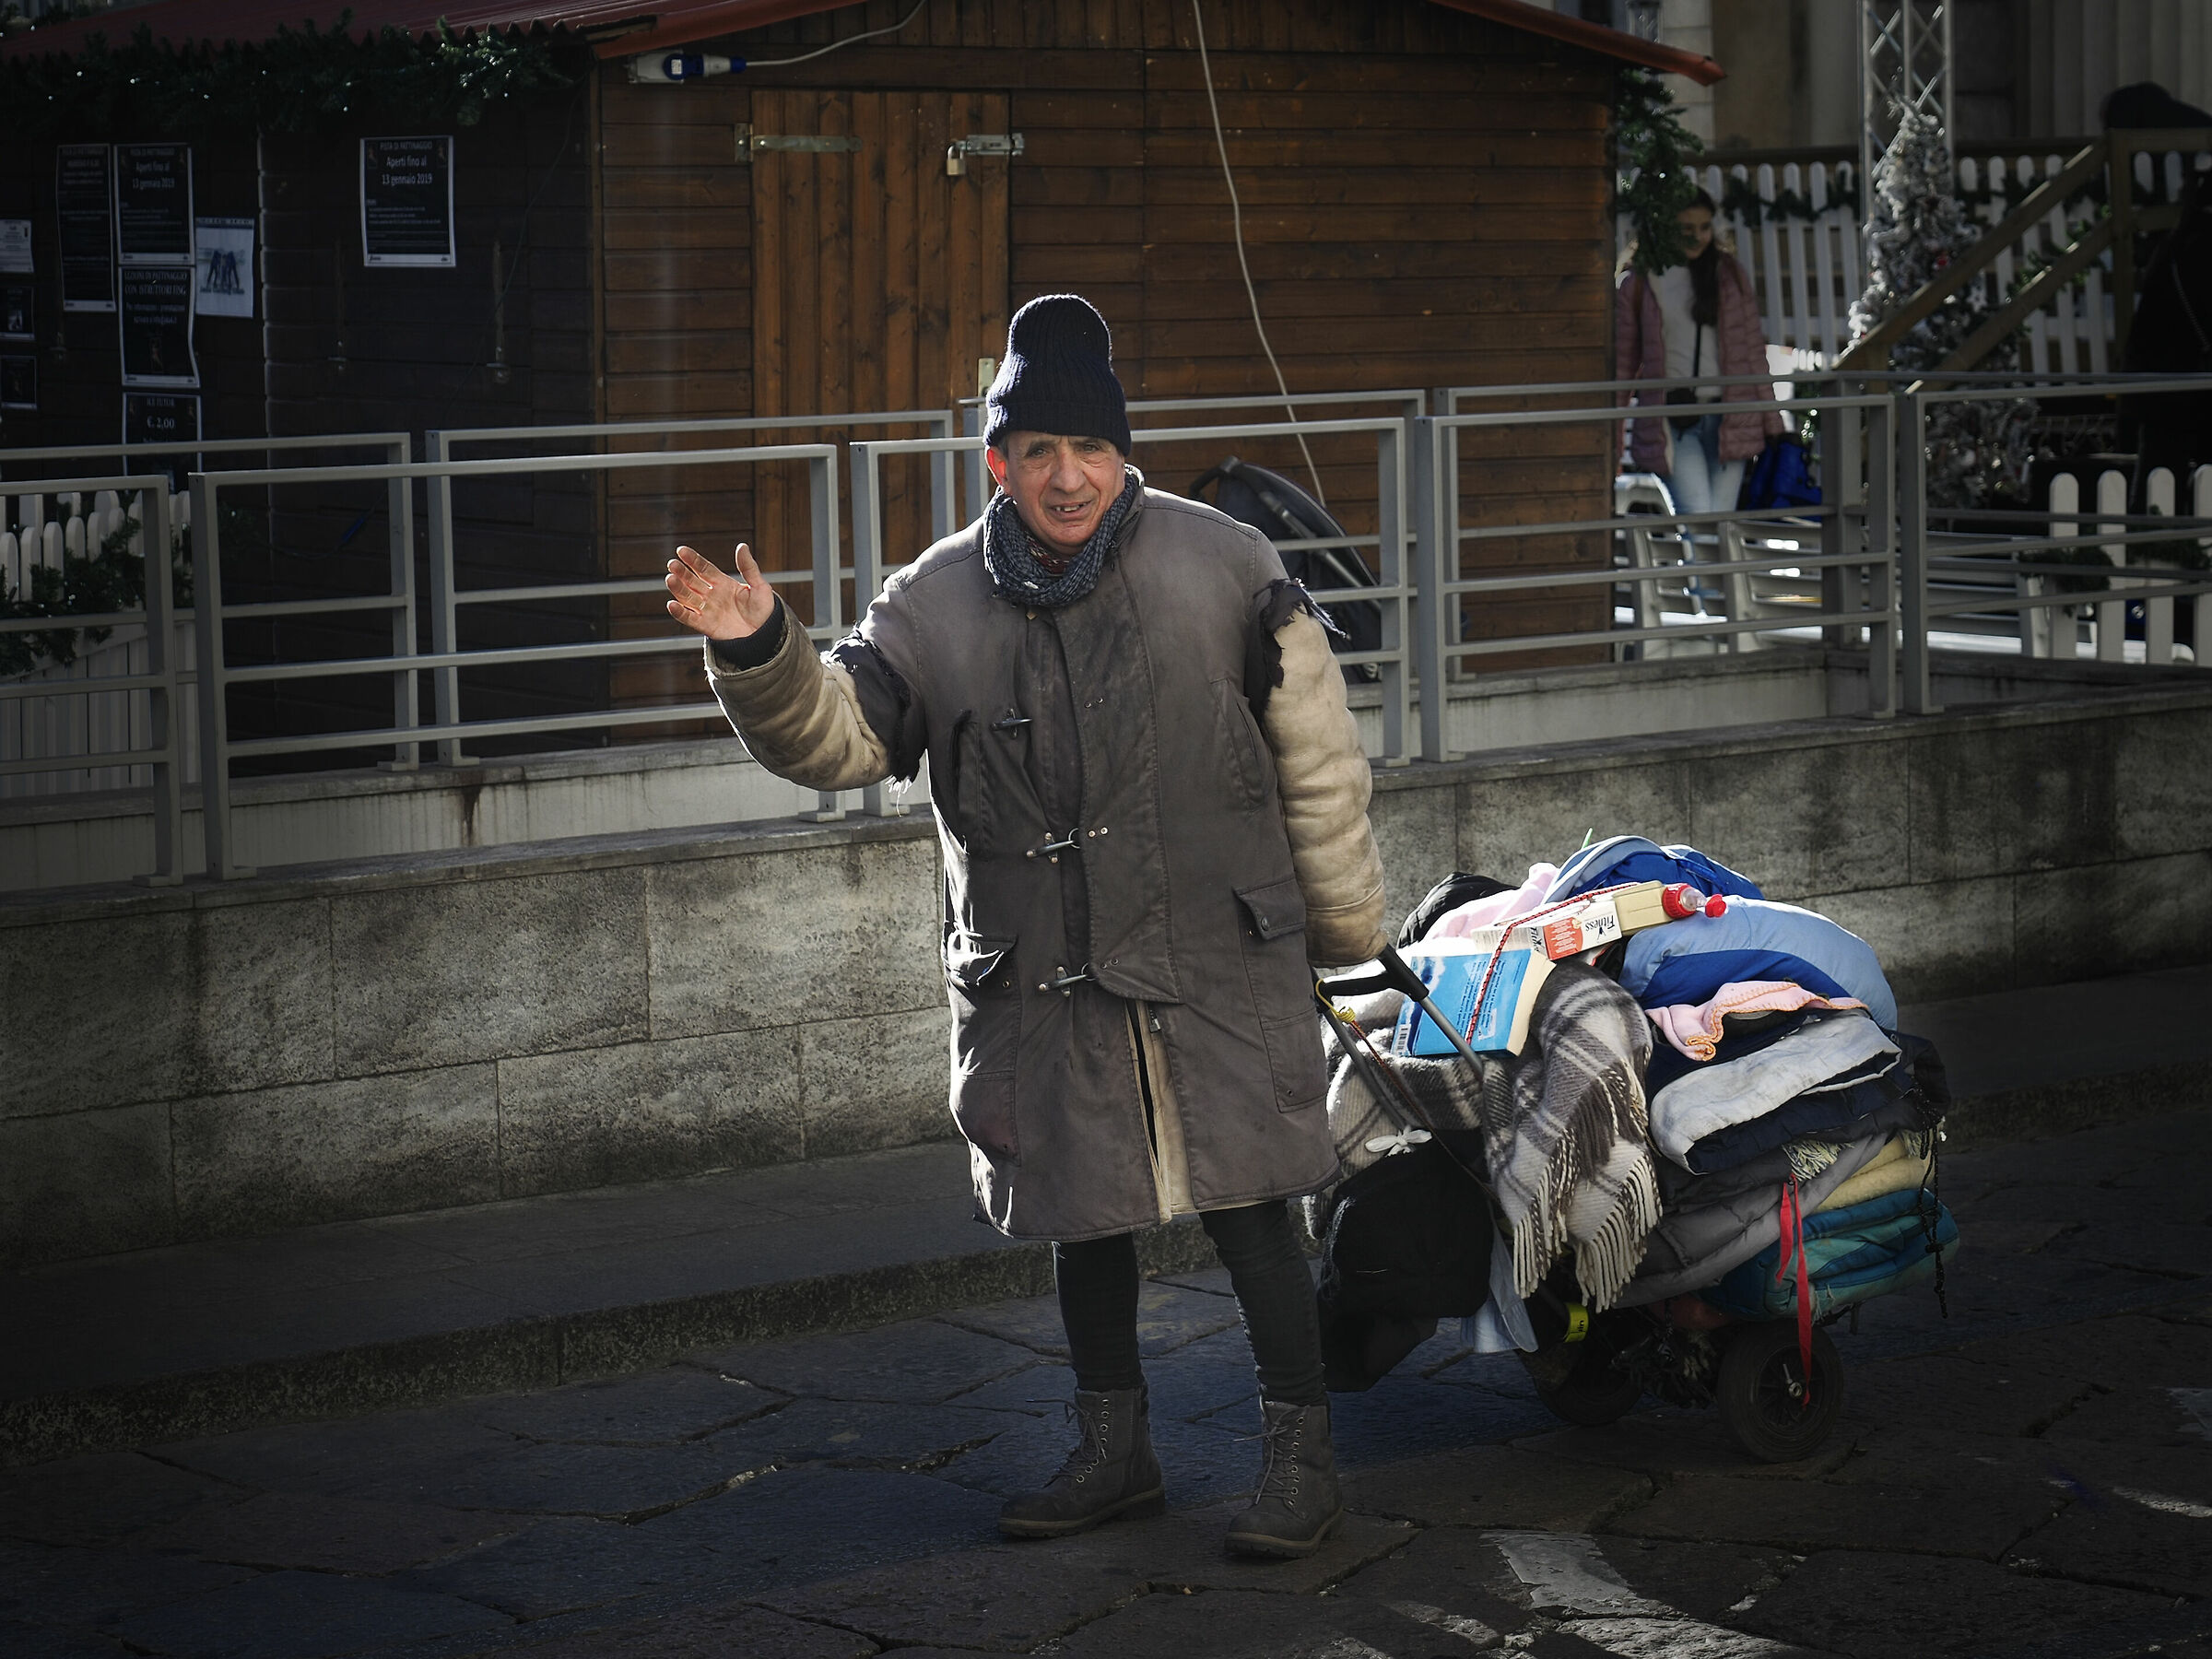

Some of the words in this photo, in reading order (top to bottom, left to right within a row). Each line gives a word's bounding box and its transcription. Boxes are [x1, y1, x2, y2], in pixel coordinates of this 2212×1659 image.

[386, 156, 406, 169] Aperti
[406, 155, 419, 167] fino
[420, 155, 427, 167] al
[382, 173, 390, 185] 13
[391, 173, 416, 187] gennaio
[417, 172, 433, 185] 2019
[1584, 914, 1616, 931] Fitness
